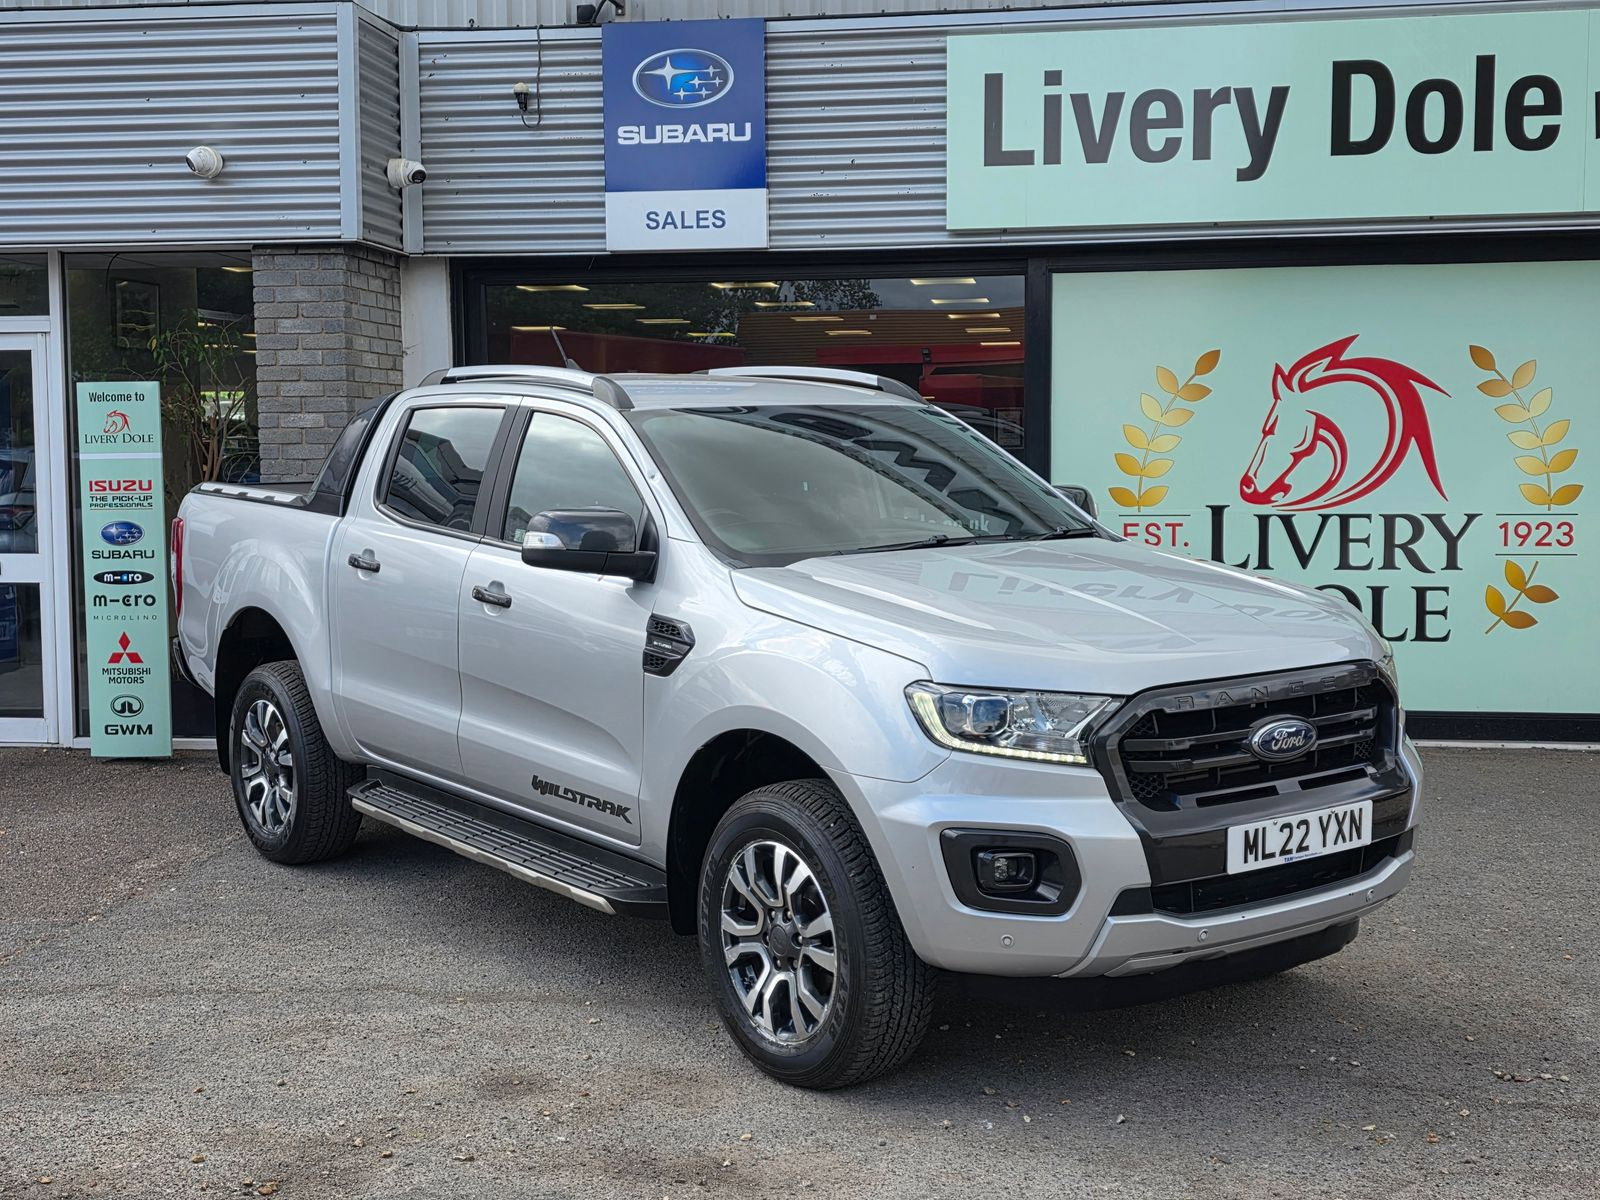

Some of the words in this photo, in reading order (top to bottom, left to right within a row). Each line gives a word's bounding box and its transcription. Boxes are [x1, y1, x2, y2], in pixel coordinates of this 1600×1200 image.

[983, 69, 1291, 182] Livery
[1330, 54, 1563, 156] Dole
[617, 122, 752, 145] SUBARU
[645, 209, 727, 230] SALES
[88, 391, 132, 402] Welcome
[135, 391, 145, 402] to
[84, 433, 119, 444] LIVERY
[122, 433, 154, 443] DOLE
[89, 479, 152, 492] ISUZU
[1123, 522, 1189, 547] EST.
[1205, 504, 1484, 574] LIVERY
[1498, 520, 1576, 548] 1923
[91, 550, 155, 559] SUBARU
[1314, 583, 1451, 642] LE
[102, 667, 151, 676] MITSUBISHI
[108, 676, 145, 684] MOTORS
[104, 724, 153, 736] GWM
[1271, 727, 1307, 750] Ford
[531, 774, 633, 825] WILDTRAK
[1243, 818, 1310, 864] ML22
[1318, 807, 1363, 848] YXN
